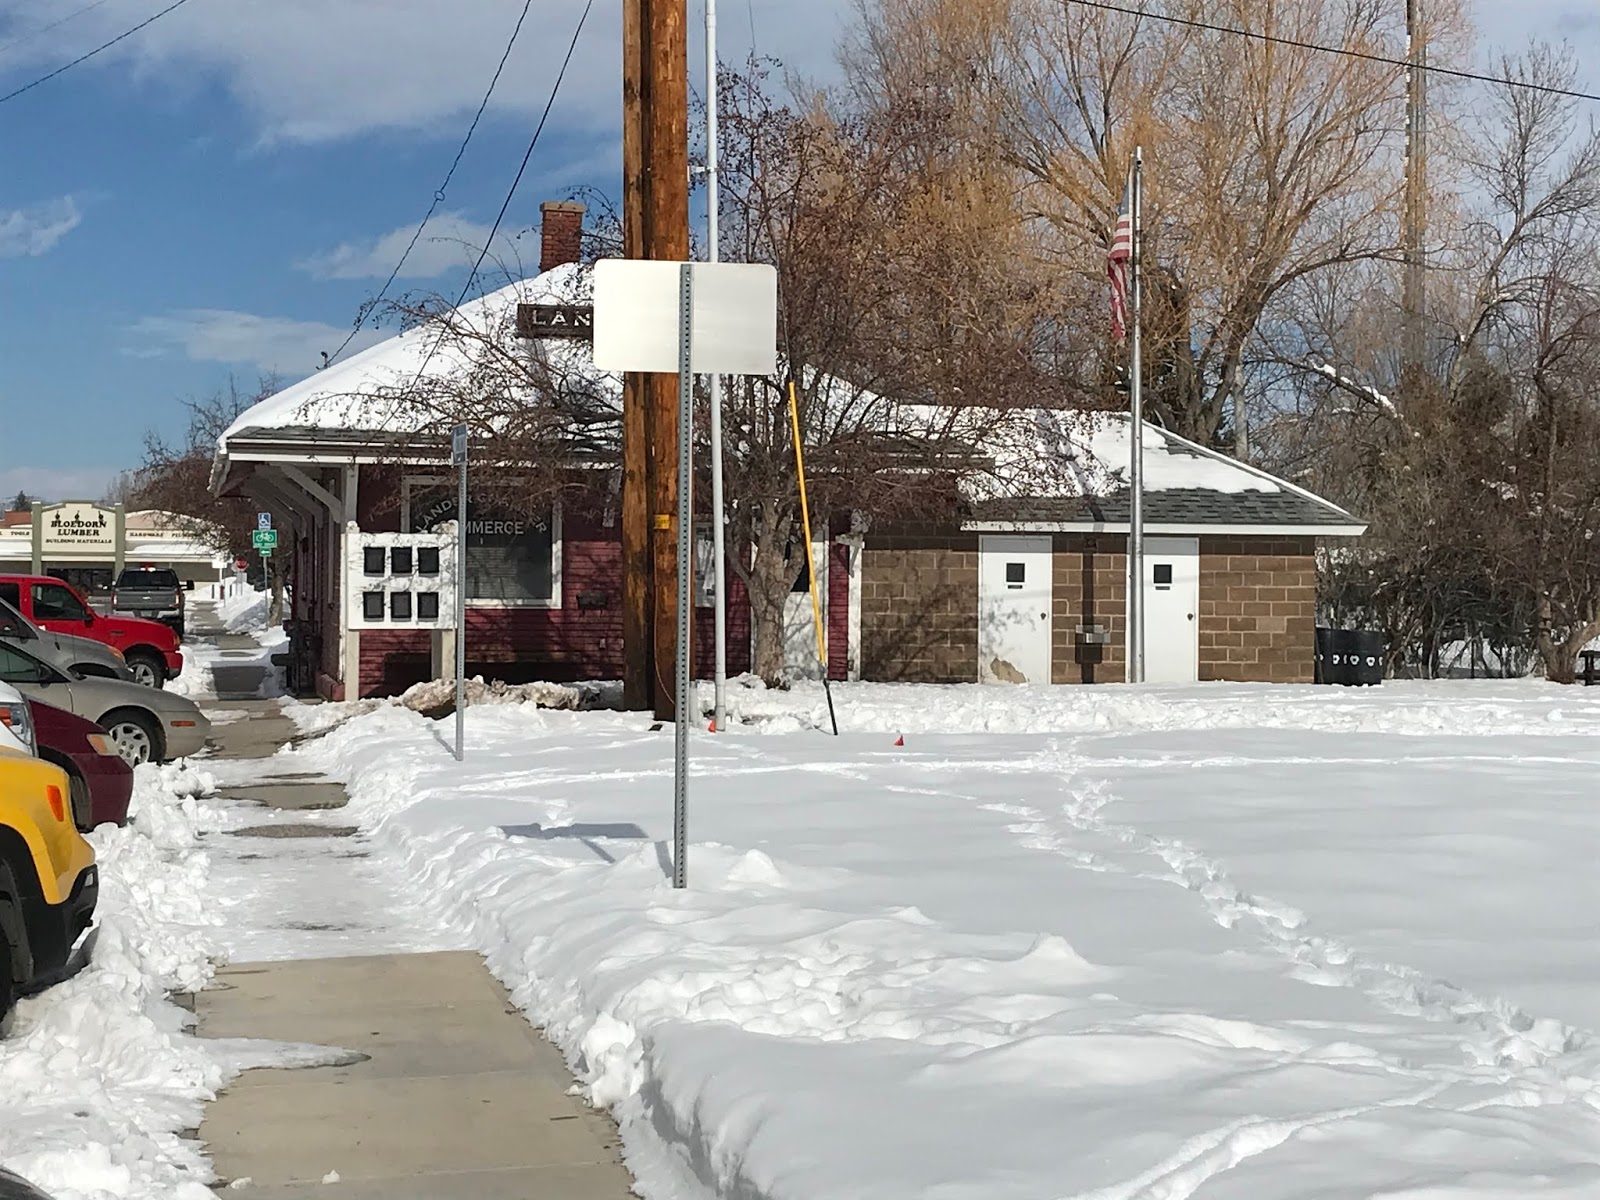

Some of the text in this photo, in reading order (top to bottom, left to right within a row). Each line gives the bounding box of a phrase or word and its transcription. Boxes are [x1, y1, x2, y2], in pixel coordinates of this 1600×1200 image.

[531, 309, 591, 327] LAN
[51, 520, 107, 528] BLOEDORN
[465, 520, 525, 534] MMERCE
